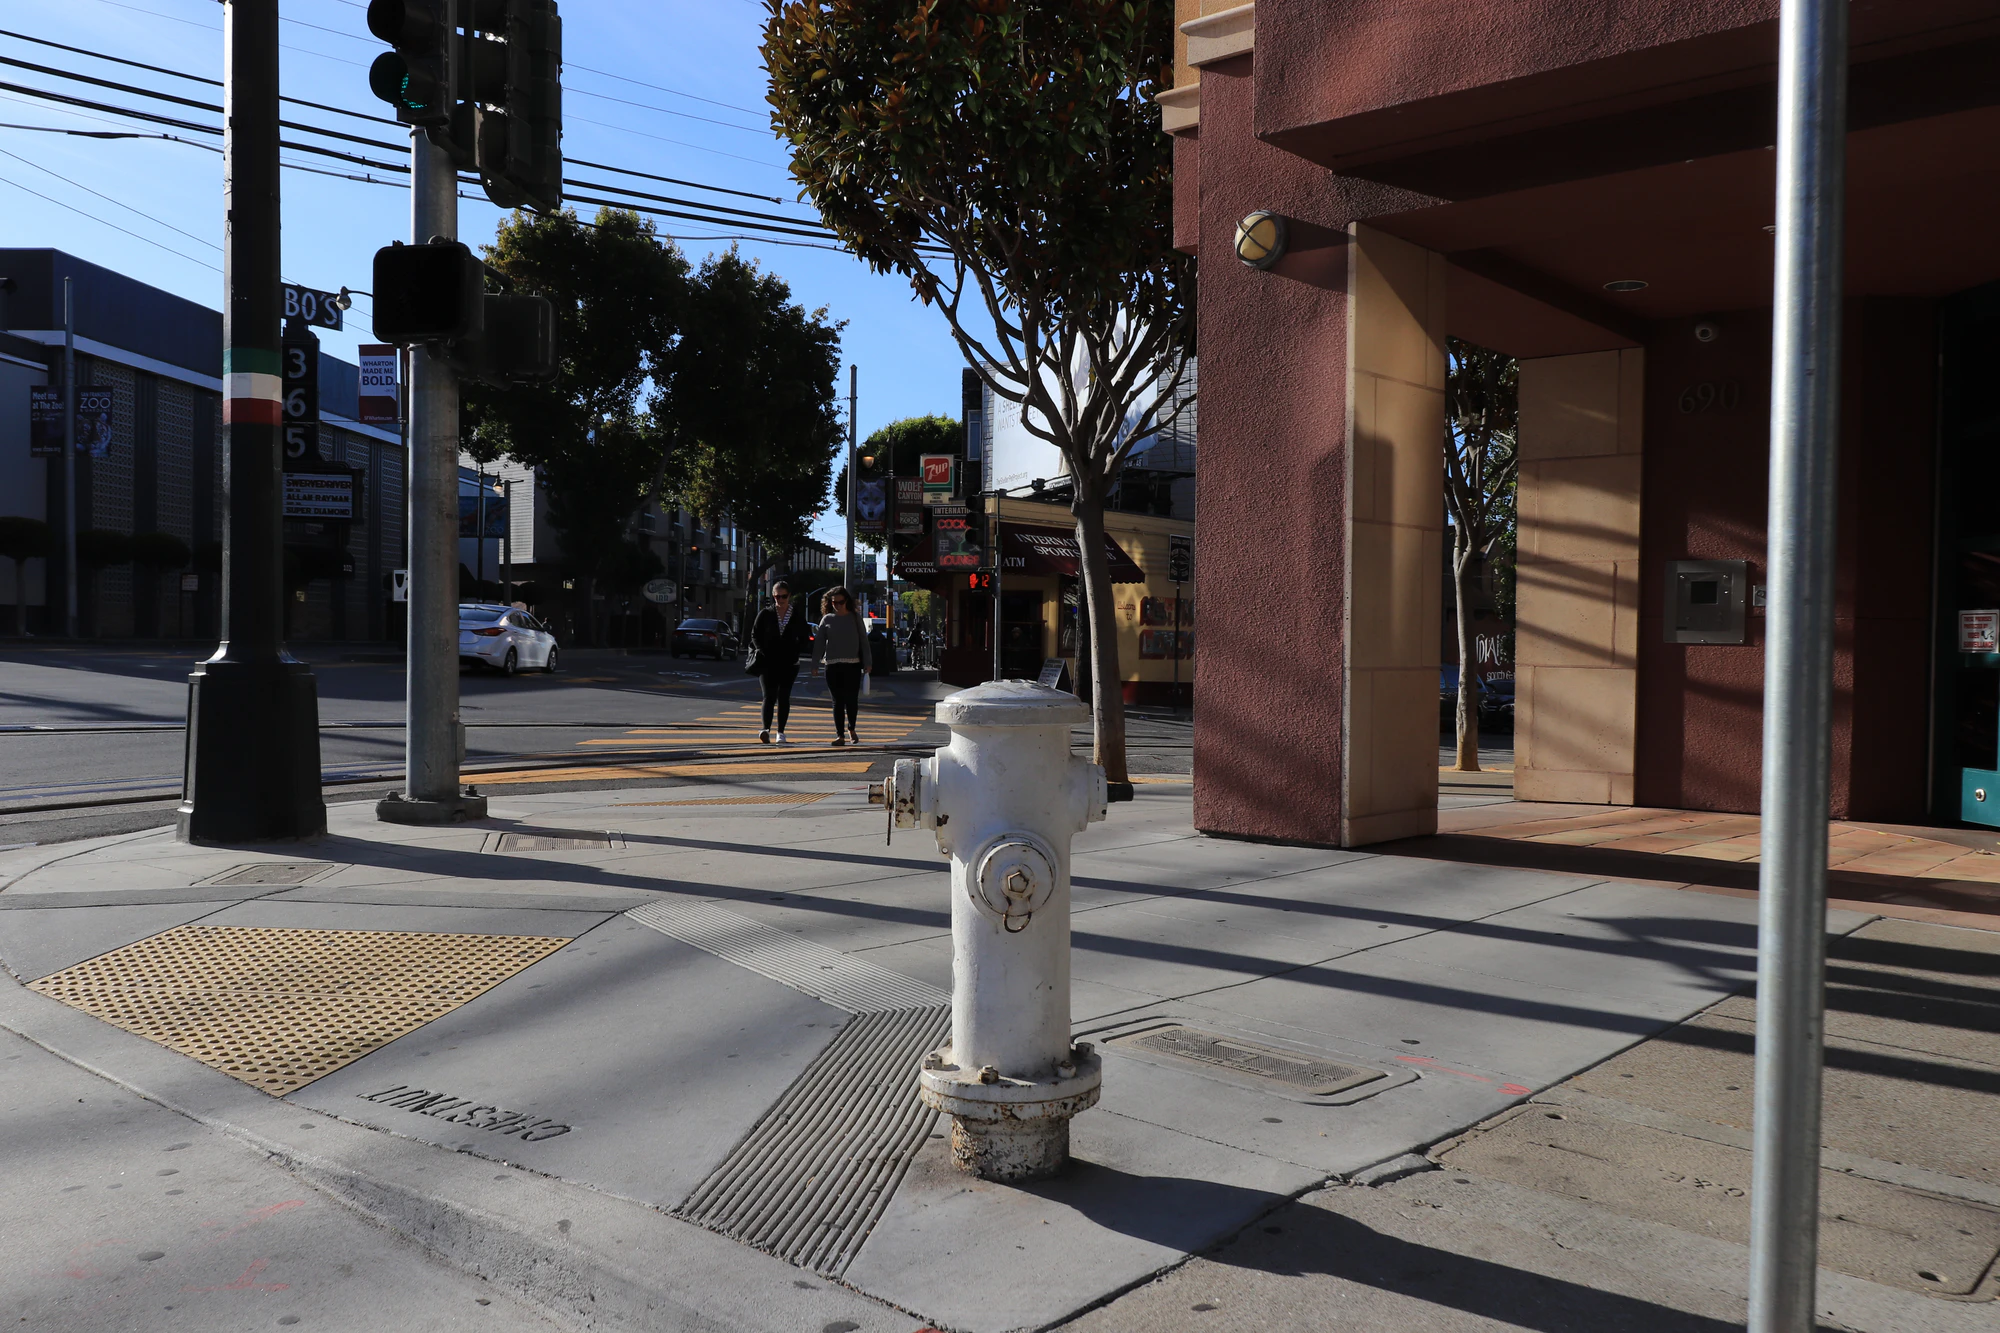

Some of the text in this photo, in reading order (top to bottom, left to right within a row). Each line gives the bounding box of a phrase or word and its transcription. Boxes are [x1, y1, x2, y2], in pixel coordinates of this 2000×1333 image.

[362, 375, 396, 386] BOLD.
[32, 392, 47, 400] Meet
[1677, 381, 1740, 414] 690
[39, 401, 51, 409] The
[51, 401, 65, 409] Zoo!
[80, 397, 111, 409] ZOO
[925, 462, 948, 481] 7UP
[285, 479, 352, 489] SWERVEDRIVER
[897, 481, 922, 492] WOLF
[286, 493, 350, 503] ALLAN RAYMAN
[286, 506, 351, 516] SUPER DIAMOND
[934, 507, 969, 515] INTERNATI
[1033, 545, 1082, 558] SPORTS
[939, 555, 980, 566] LOUNGE
[1002, 556, 1026, 568] ATM
[981, 574, 990, 588] 12
[356, 1083, 573, 1141] CHESTNUT
